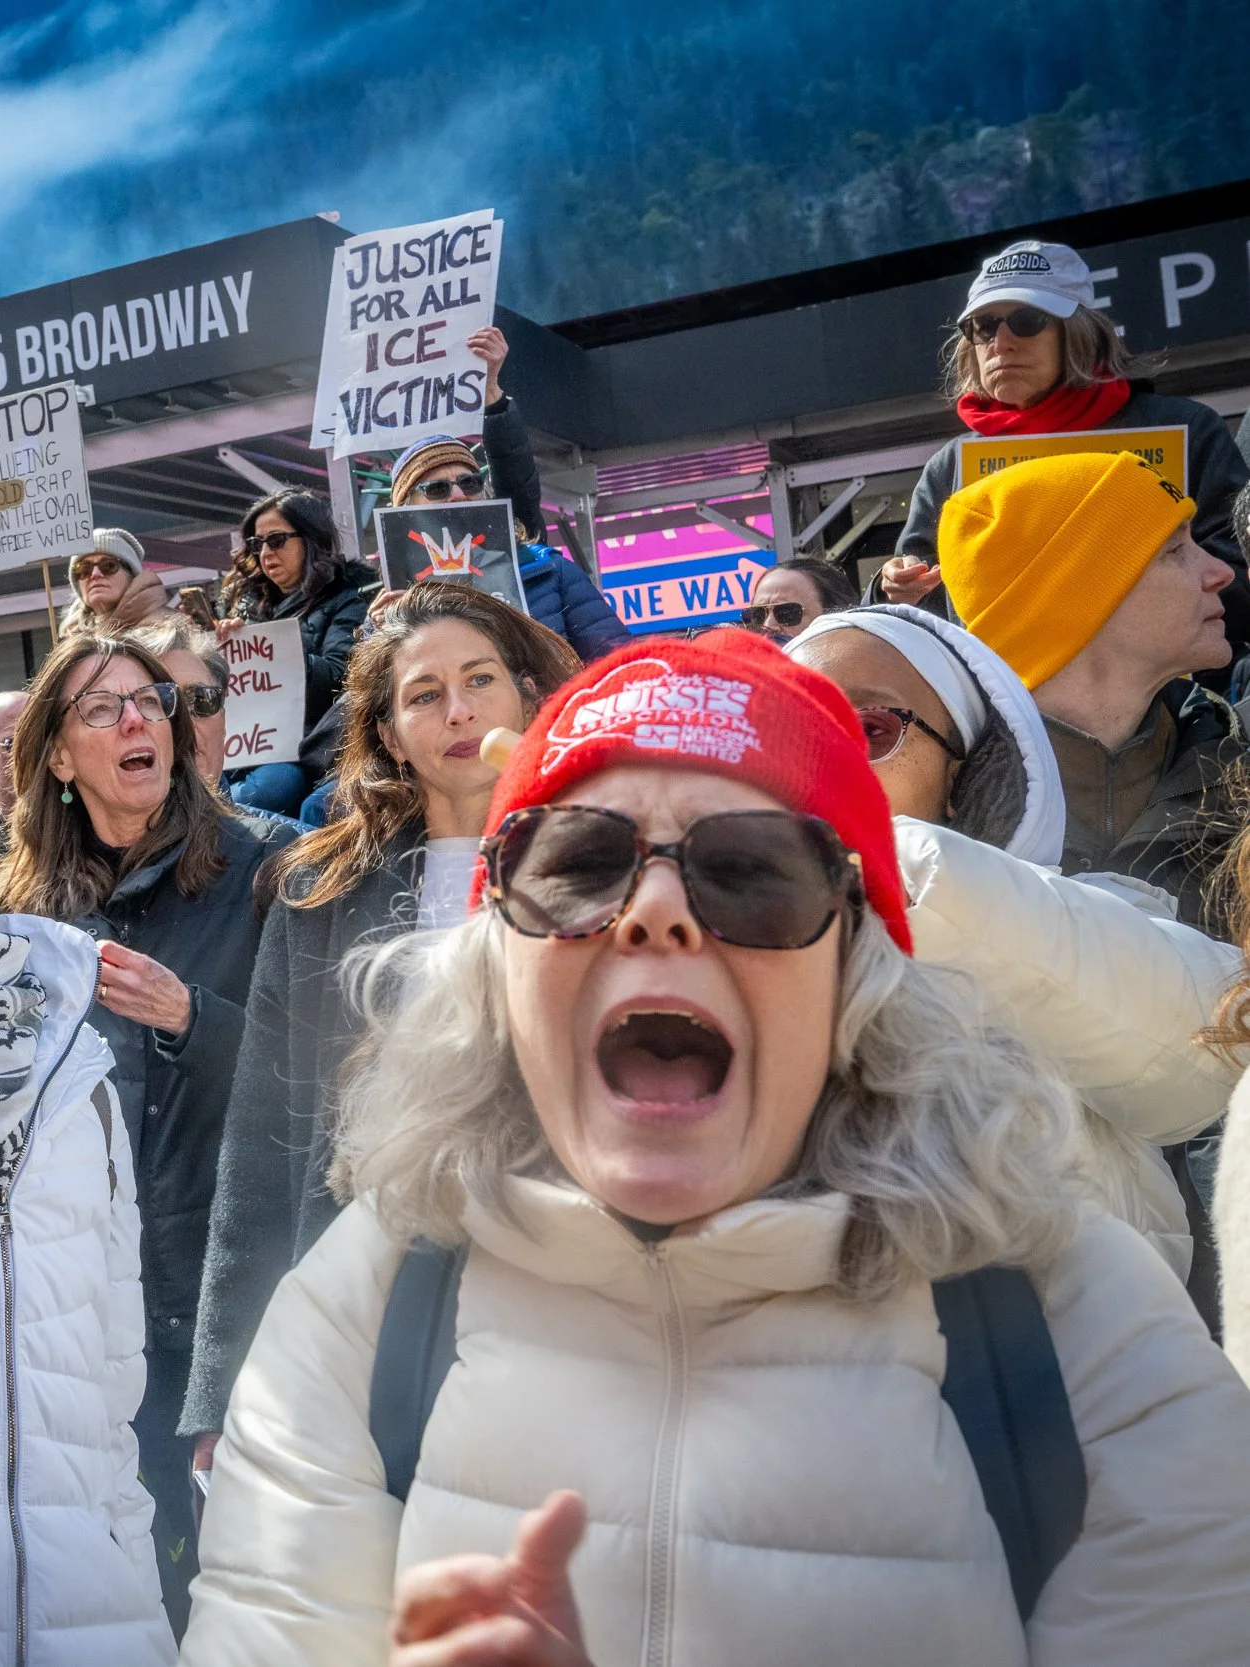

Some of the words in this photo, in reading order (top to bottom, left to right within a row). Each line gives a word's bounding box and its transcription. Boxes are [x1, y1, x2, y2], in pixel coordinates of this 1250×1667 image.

[347, 224, 492, 290] JUSTICE
[990, 253, 1049, 273] ROADSIDE
[350, 289, 410, 330] FOR
[417, 277, 481, 316] ALL
[15, 271, 253, 386] BROADWAY
[366, 320, 447, 373] ICE
[339, 370, 486, 435] VICTIMS
[980, 457, 1006, 474] END
[24, 469, 73, 498] CRAP
[12, 502, 45, 528] THE
[45, 493, 88, 520] OVAL
[36, 520, 90, 548] WALLS
[679, 571, 753, 611] WAY
[220, 635, 273, 664] THING
[226, 670, 282, 697] RFUL
[572, 686, 750, 727] NURSES
[224, 723, 277, 758] OVE
